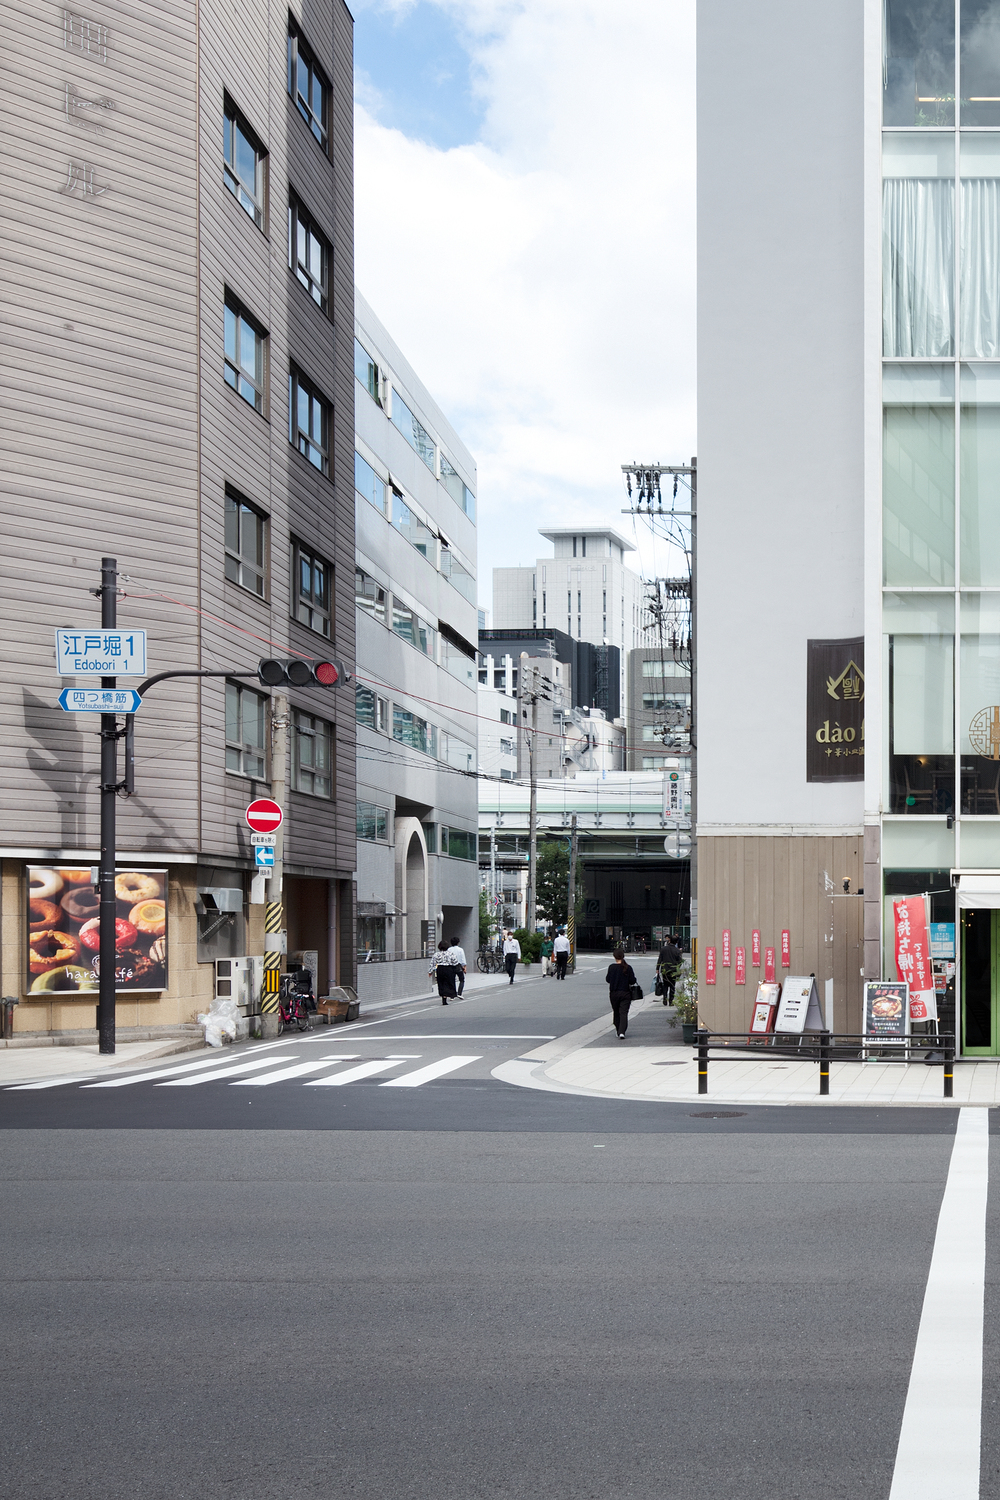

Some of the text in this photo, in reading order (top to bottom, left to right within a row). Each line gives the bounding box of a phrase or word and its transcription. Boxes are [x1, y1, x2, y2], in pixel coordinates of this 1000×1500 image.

[64, 635, 133, 656] 江戸堀1
[75, 659, 128, 670] Edobori 1
[73, 692, 126, 703] 四つ橋筋
[78, 703, 124, 711] Yotsubashi-suji
[816, 720, 855, 743] dào
